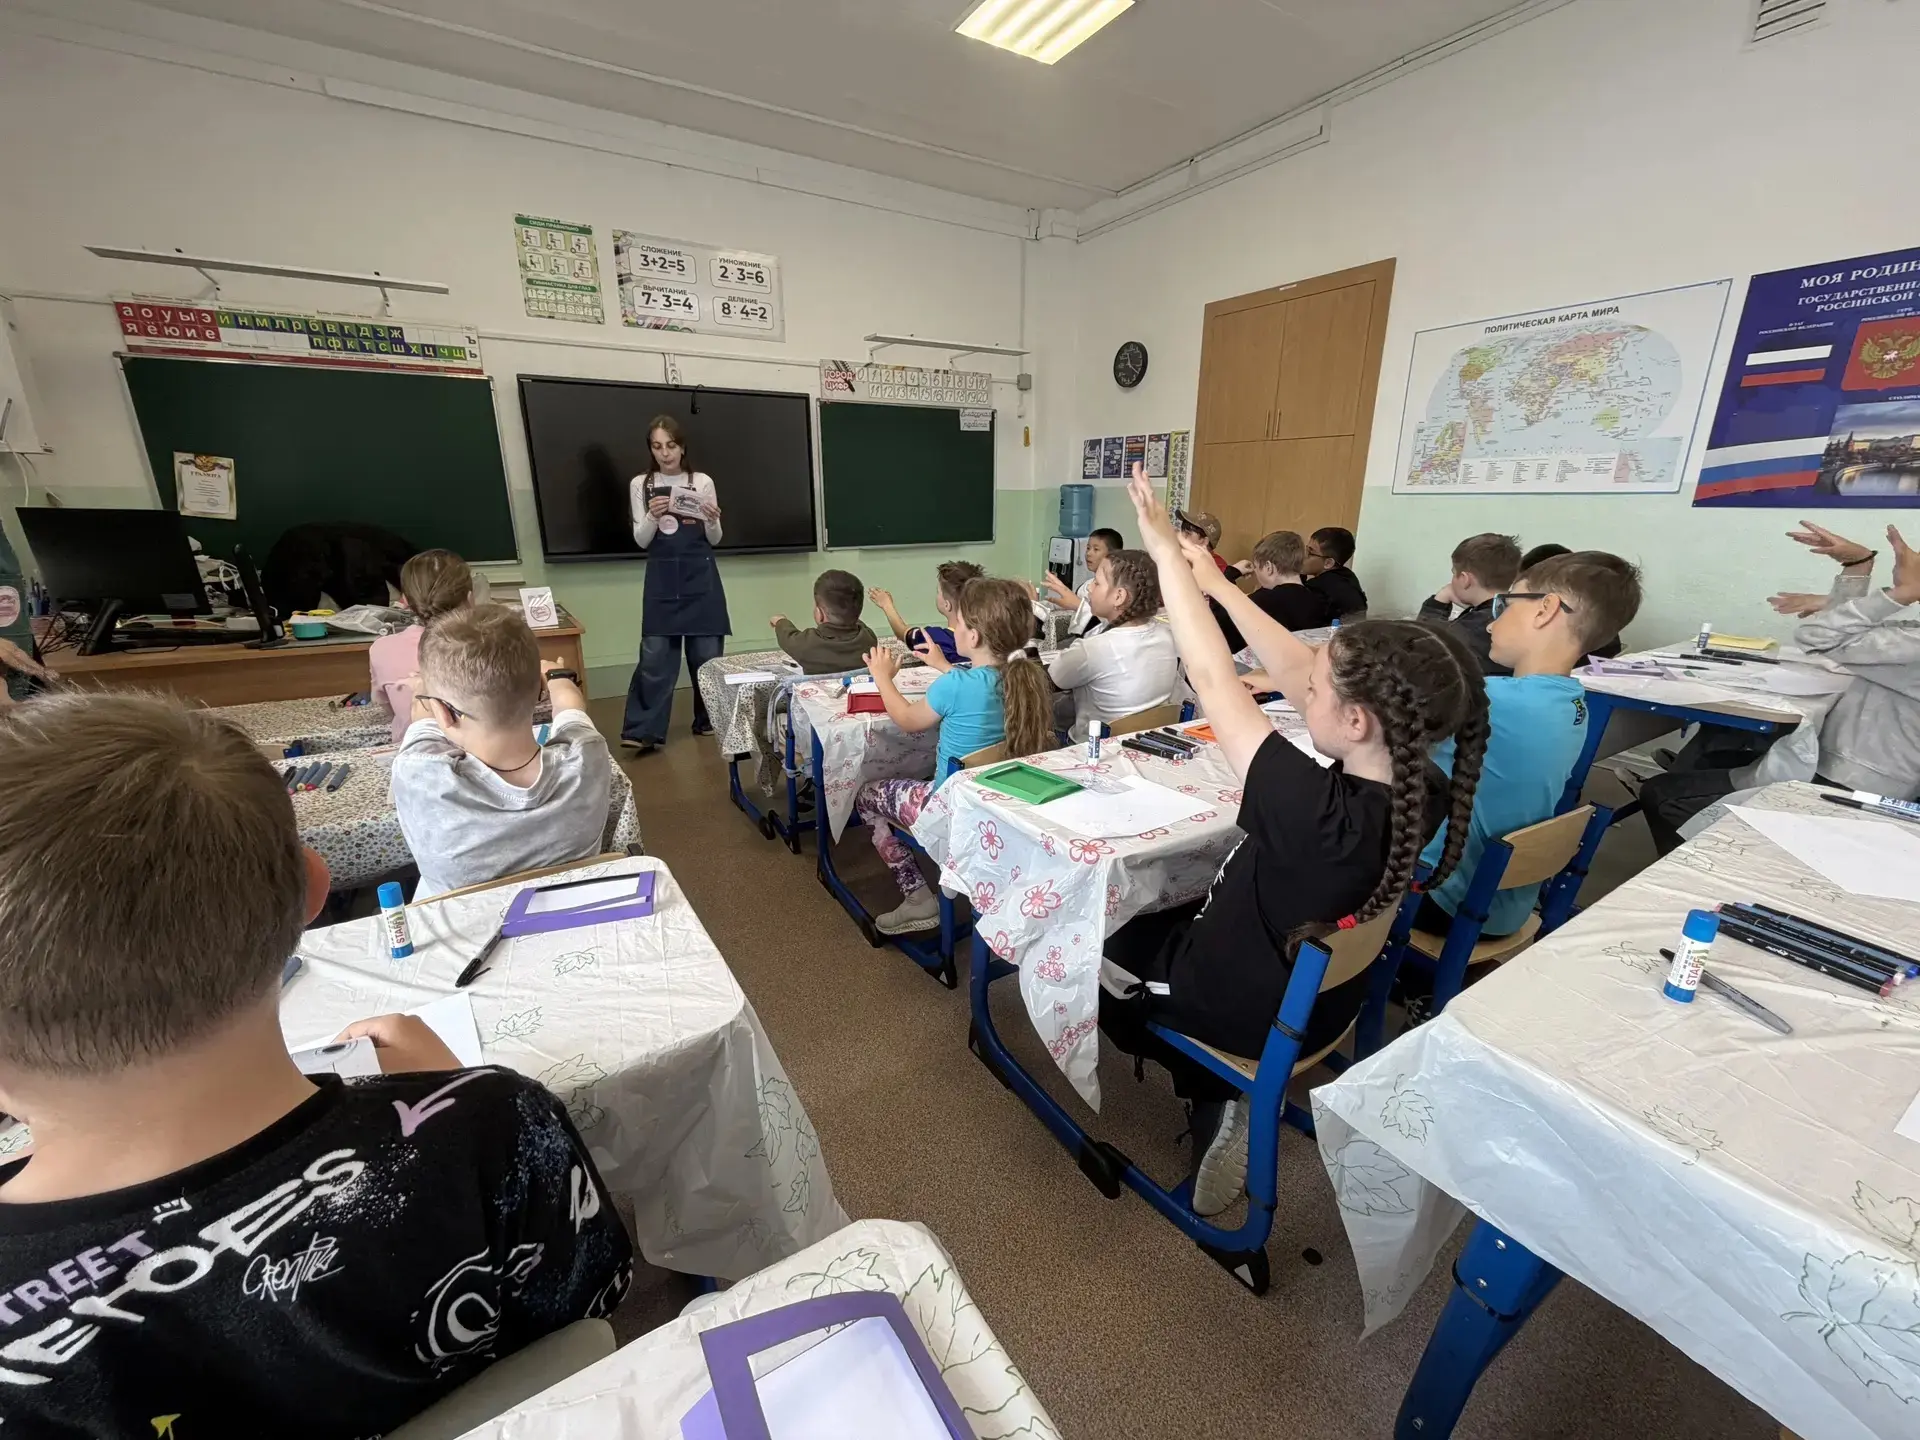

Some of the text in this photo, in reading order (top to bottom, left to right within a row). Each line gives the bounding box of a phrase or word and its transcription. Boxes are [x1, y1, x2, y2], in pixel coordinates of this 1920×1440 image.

[641, 245, 682, 257] СЛОЖЕНИЕ
[640, 254, 685, 272] 3+2=5
[719, 257, 761, 269] УМНОЖЕНИЕ
[1800, 272, 1844, 289] МОЯ
[643, 284, 688, 296] ВЫЧИТАНИЕ
[727, 295, 758, 305] ДЕЛЕНИЕ
[1815, 291, 1915, 313] РОССИЙСКОЙ
[1484, 306, 1620, 334] ПОЛИТИЧЕСКАЯ КАРТА МИРА
[825, 369, 853, 381] ГОРОД
